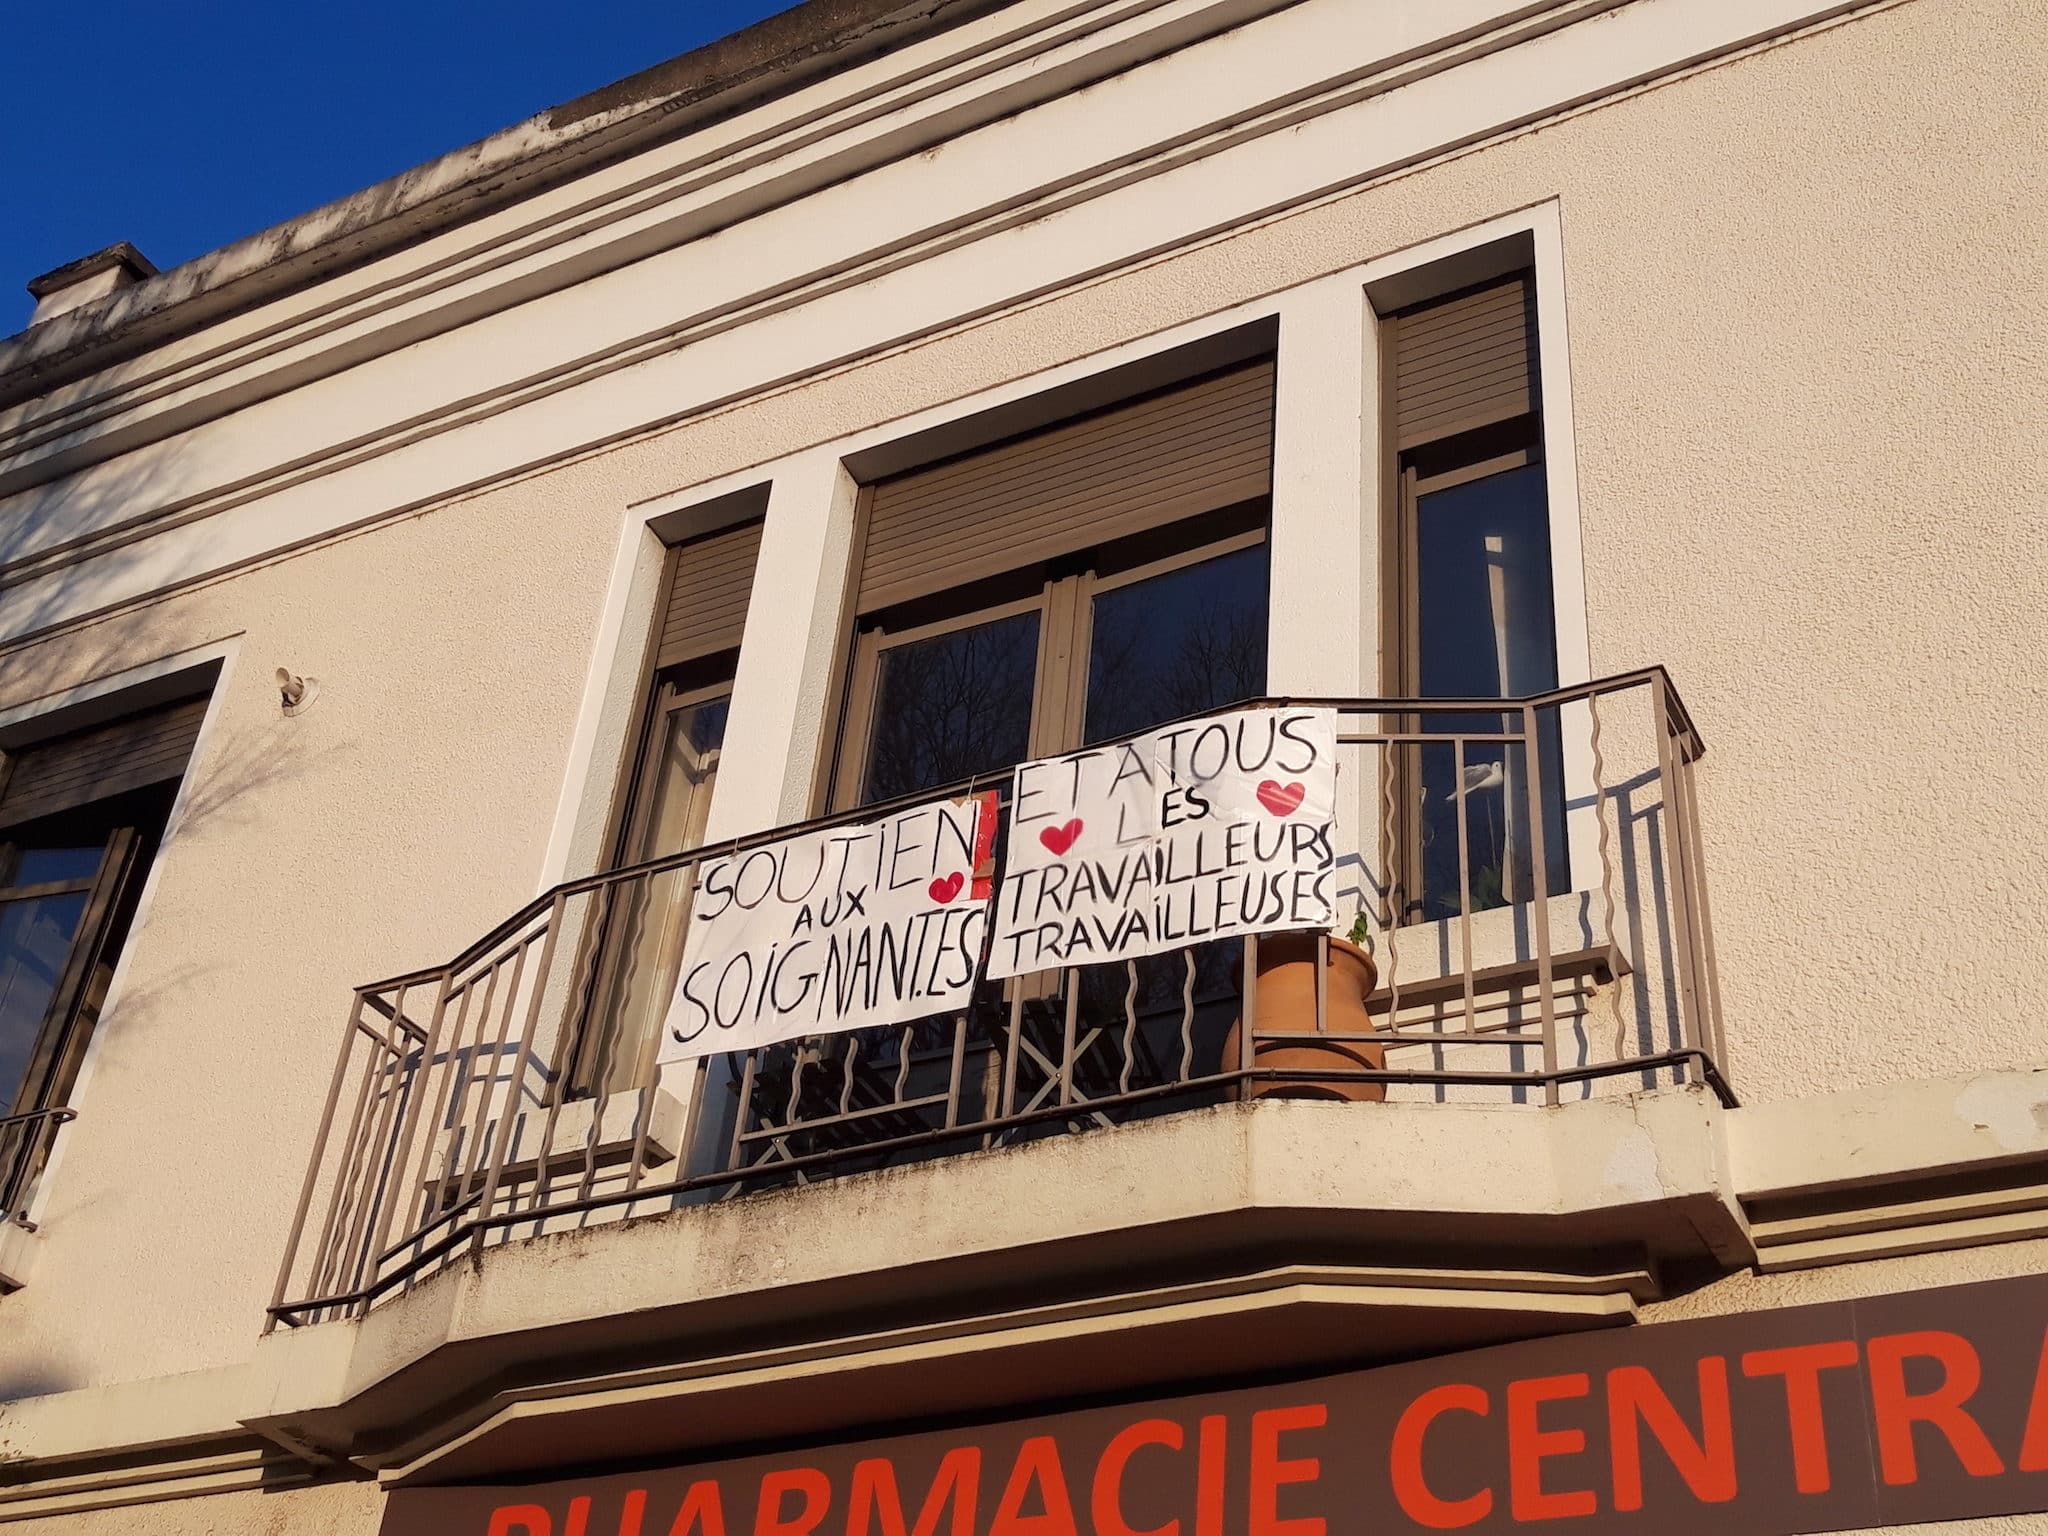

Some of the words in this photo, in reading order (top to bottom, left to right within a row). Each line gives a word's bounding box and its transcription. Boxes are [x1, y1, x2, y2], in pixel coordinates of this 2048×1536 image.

[1014, 752, 1105, 826] ET
[1156, 715, 1318, 785] TOUS
[1115, 786, 1211, 848] LES
[790, 884, 868, 938] AUX
[487, 1403, 1328, 1536] RMACIE
[1390, 1330, 2048, 1530] CENTR
